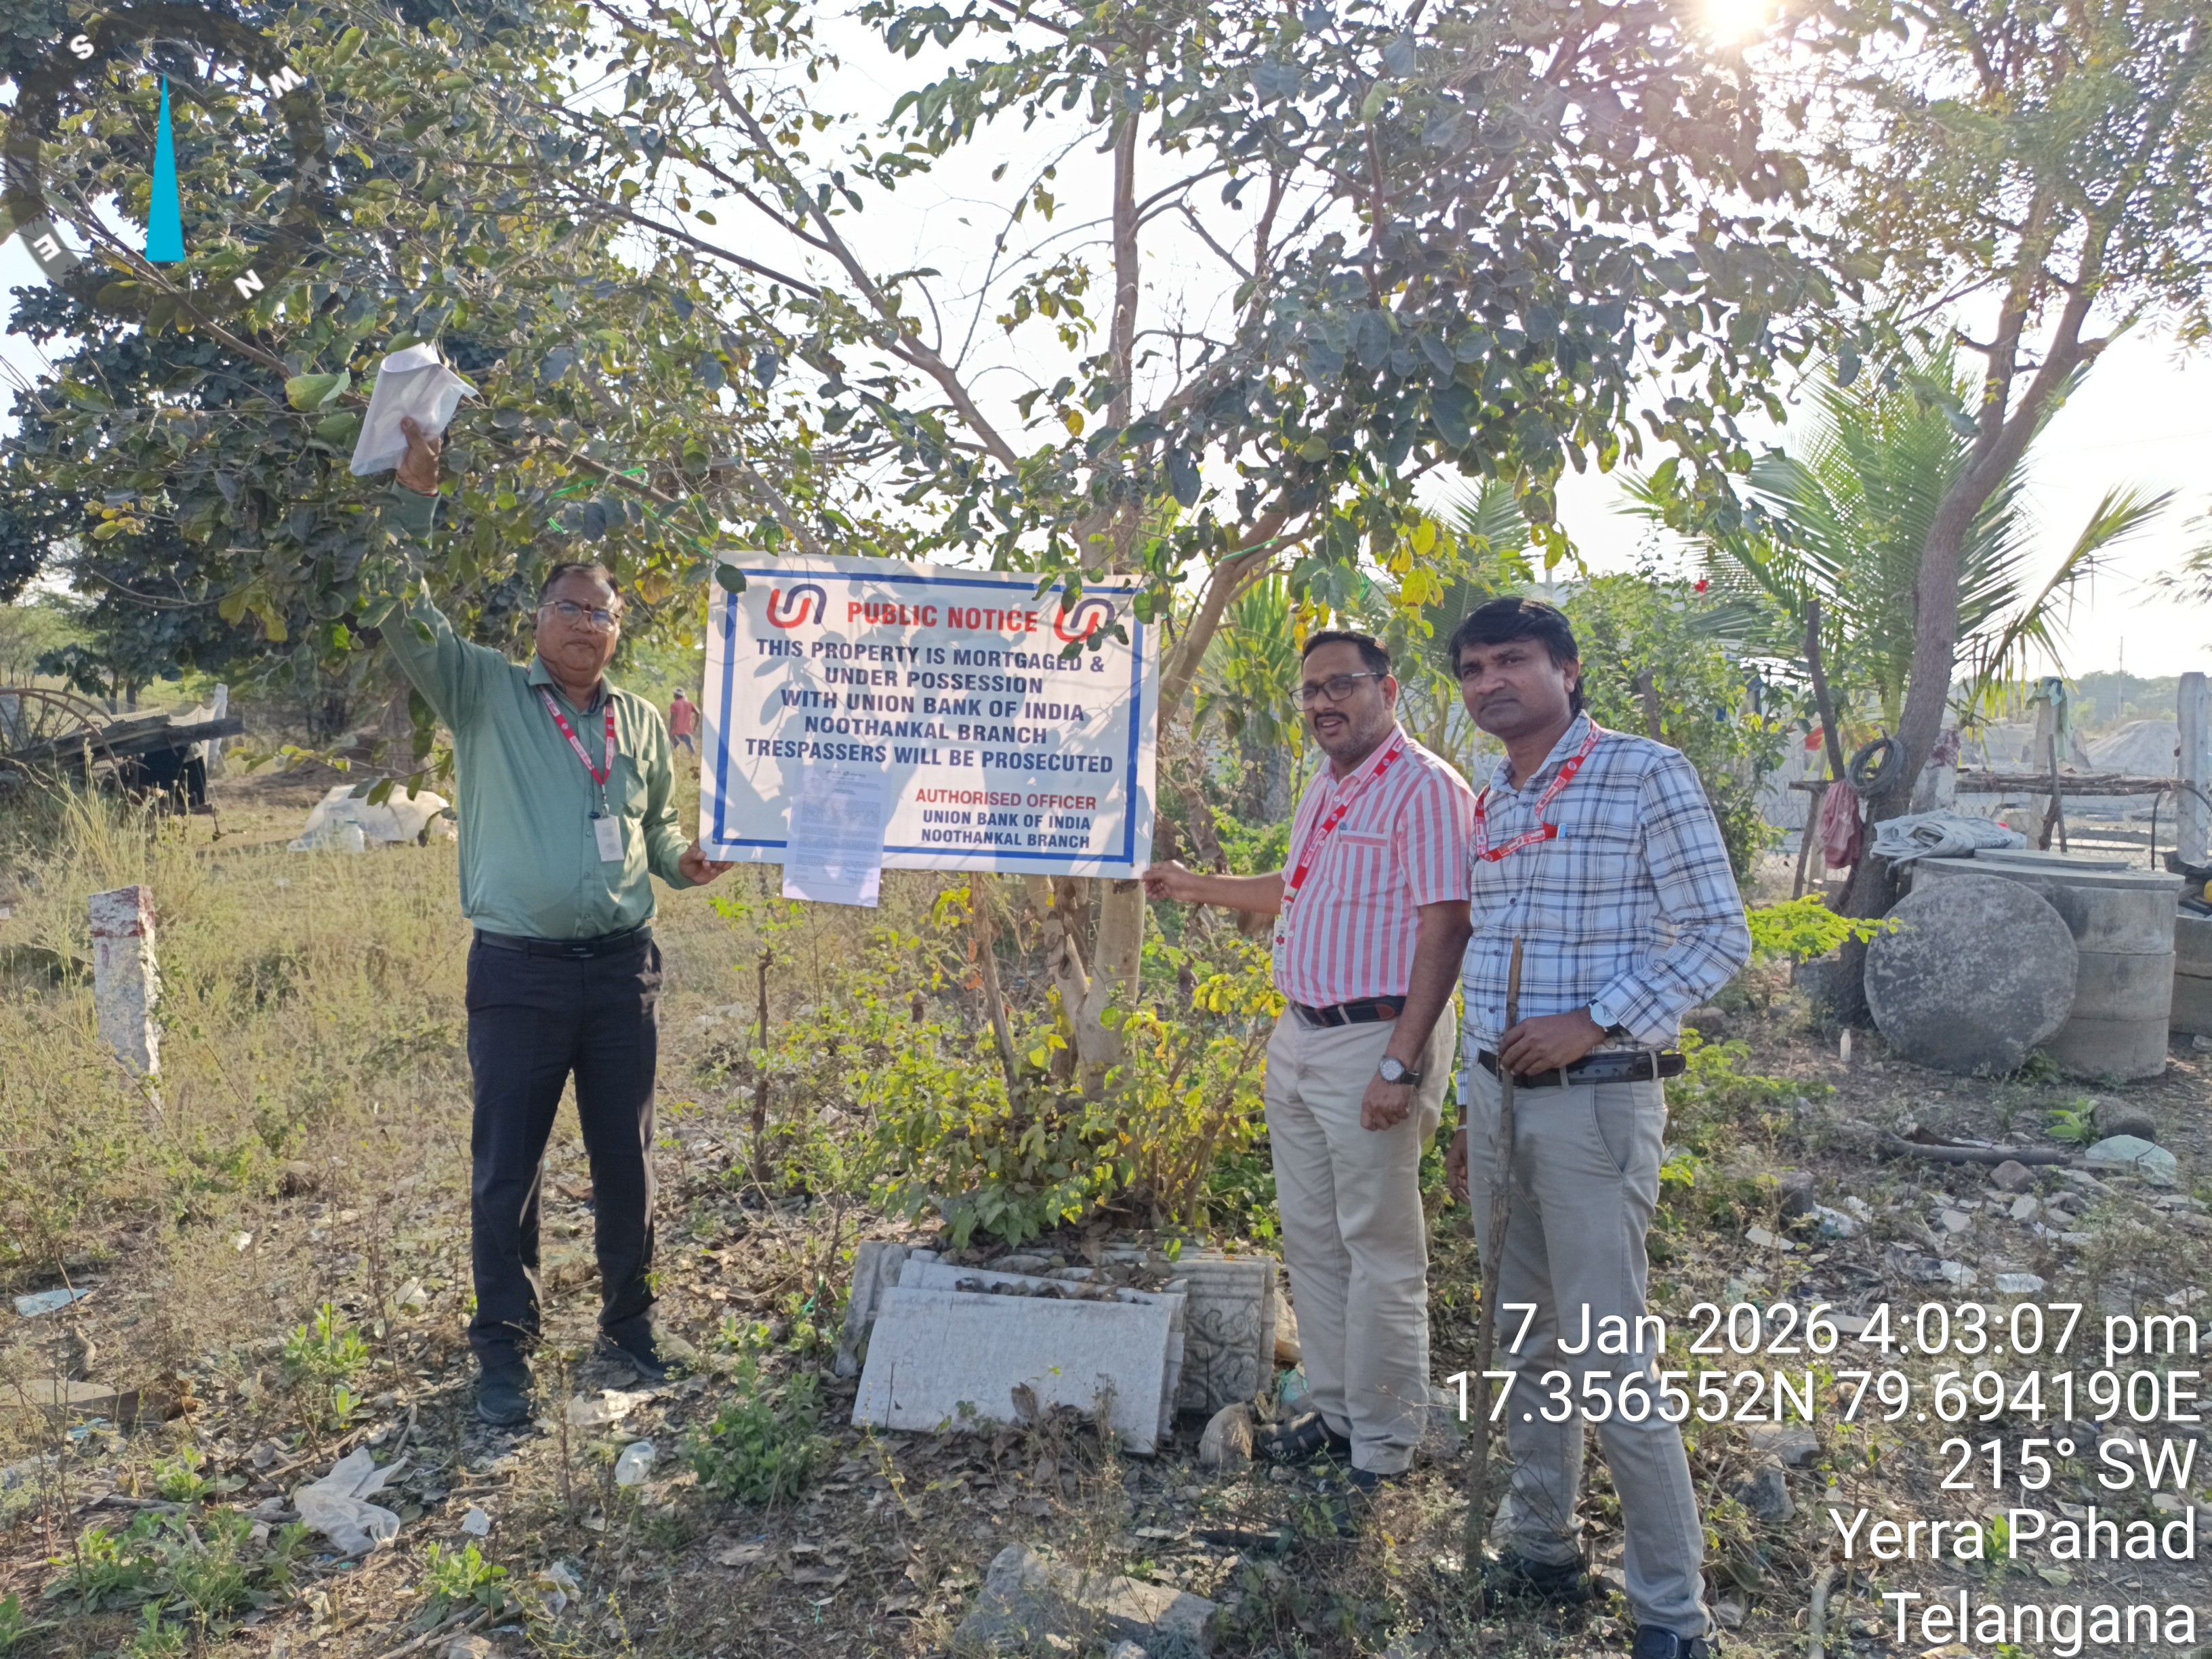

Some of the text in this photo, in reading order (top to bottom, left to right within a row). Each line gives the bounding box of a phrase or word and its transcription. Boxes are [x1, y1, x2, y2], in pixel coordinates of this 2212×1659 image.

[848, 602, 1038, 632] PUBLIC NOTICE
[756, 638, 1104, 672] THIS PROPERTY IS MORTGAGED &
[825, 667, 1042, 694] UNDER POSSESSION
[781, 689, 1084, 721] WITH UNION BANK OF INDIA
[805, 716, 1046, 744] NOOTHANKAL BRANCH
[745, 739, 1113, 773] TRESPASSERS WILL BE PROSECUTED
[916, 789, 1096, 810] AUTHORISED OFFICER
[923, 810, 1090, 830] UNION BANK OF INDIA
[922, 829, 1089, 848] NOOTHANKAL BRANCH
